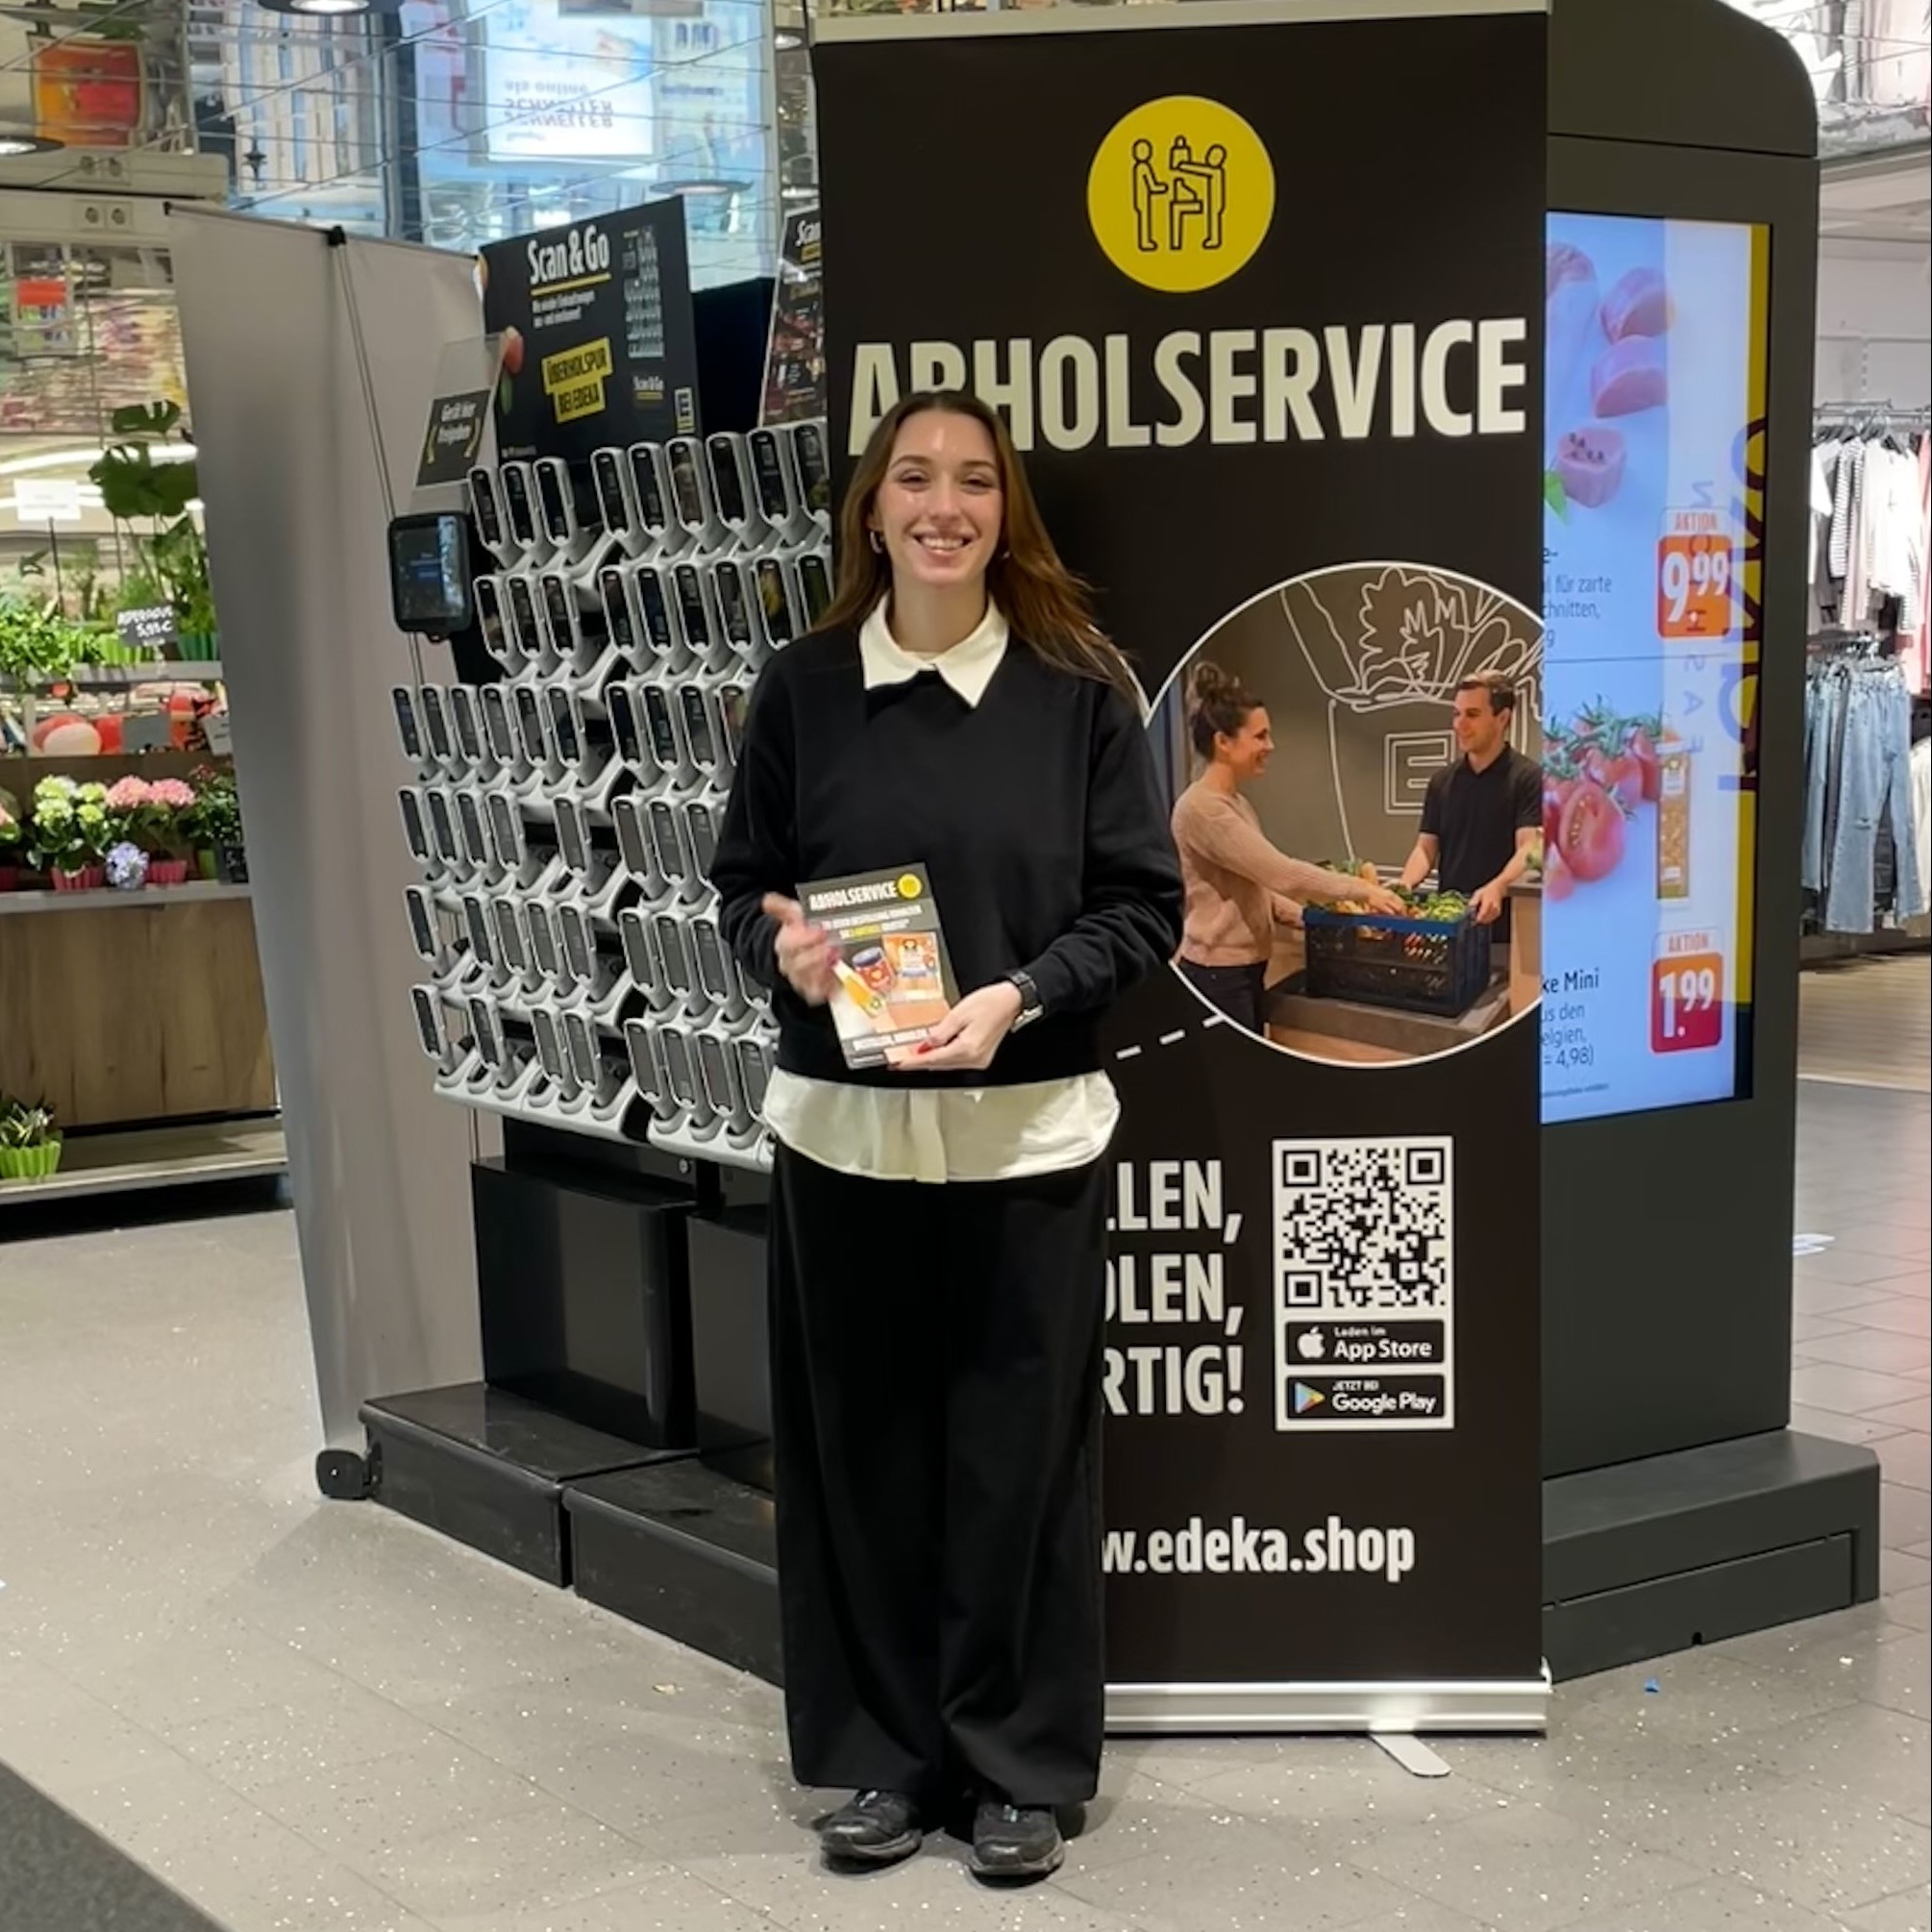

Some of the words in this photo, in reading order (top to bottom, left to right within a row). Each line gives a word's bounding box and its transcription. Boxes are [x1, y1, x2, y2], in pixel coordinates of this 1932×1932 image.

[1674, 511, 1718, 533] AKTION
[1577, 577, 1612, 593] zarte
[1668, 932, 1710, 953] AKTION
[1563, 967, 1600, 993] Mini
[1559, 1003, 1585, 1021] den
[1106, 1160, 1243, 1245] LEN,
[1333, 1326, 1370, 1338] Laden
[1371, 1325, 1387, 1337] im
[1333, 1339, 1377, 1363] App
[1377, 1338, 1433, 1358] Store
[1331, 1379, 1362, 1392] JETZT
[1331, 1392, 1398, 1416] Google
[1399, 1391, 1437, 1414] Play
[1102, 1515, 1416, 1583] w.edeka.shop
